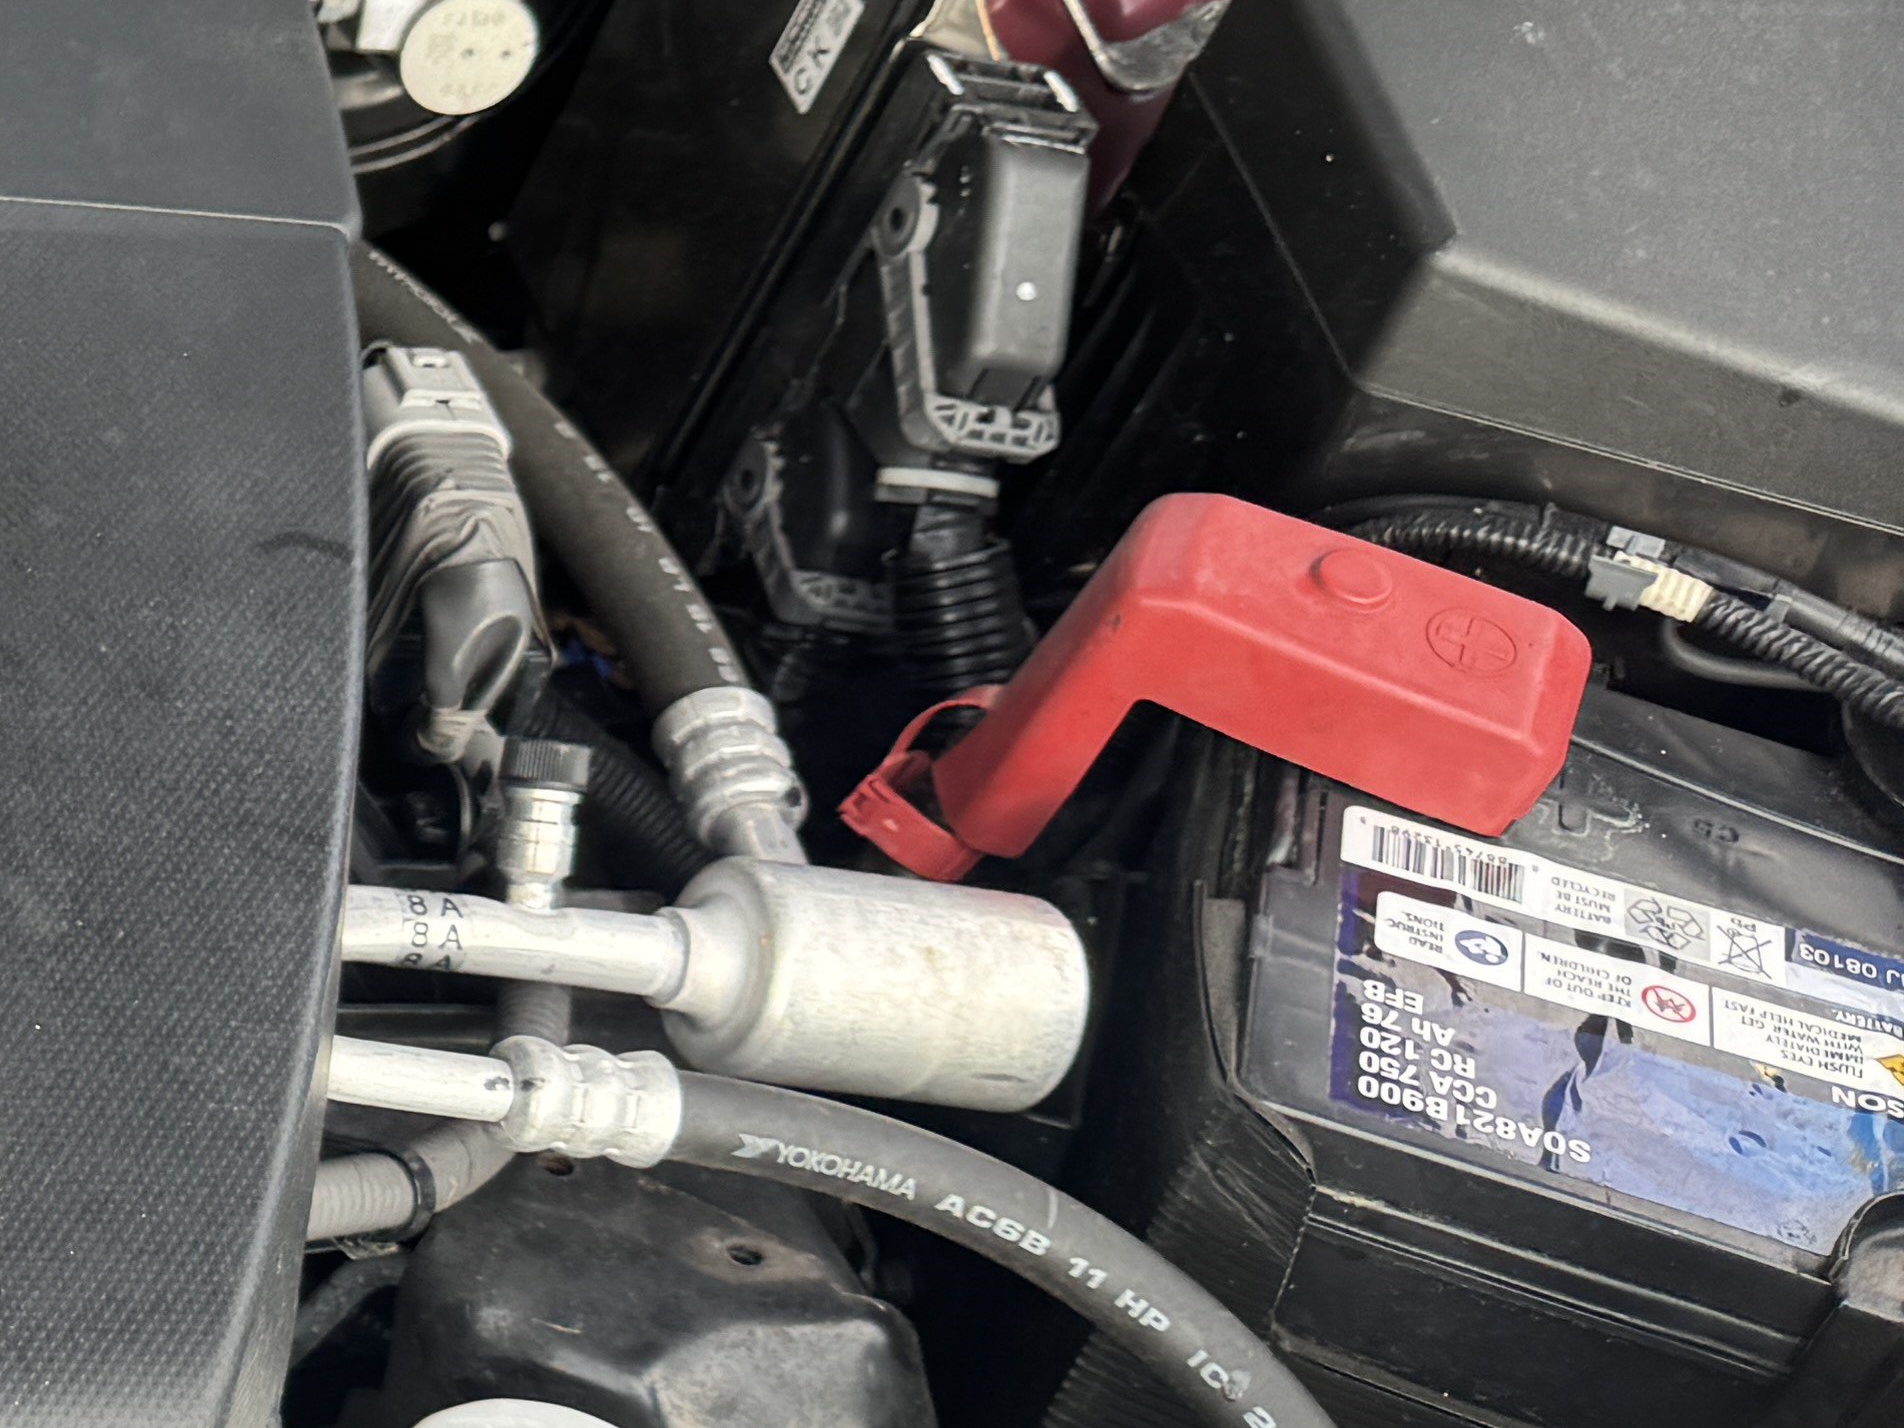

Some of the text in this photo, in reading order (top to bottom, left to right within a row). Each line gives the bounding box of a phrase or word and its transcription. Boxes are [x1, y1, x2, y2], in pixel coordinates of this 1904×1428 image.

[407, 895, 463, 918] 8 A
[411, 922, 462, 950] 8 A
[1800, 943, 1877, 978] 08103
[1361, 979, 1424, 1015] EFB
[1360, 1003, 1455, 1042] Ah 76
[1359, 1026, 1475, 1079] RC 120
[1359, 1050, 1498, 1109] CCA 750
[776, 1143, 918, 1200] YOKOHAMA
[934, 1194, 1051, 1256] AC6B
[1114, 1289, 1170, 1332] HP
